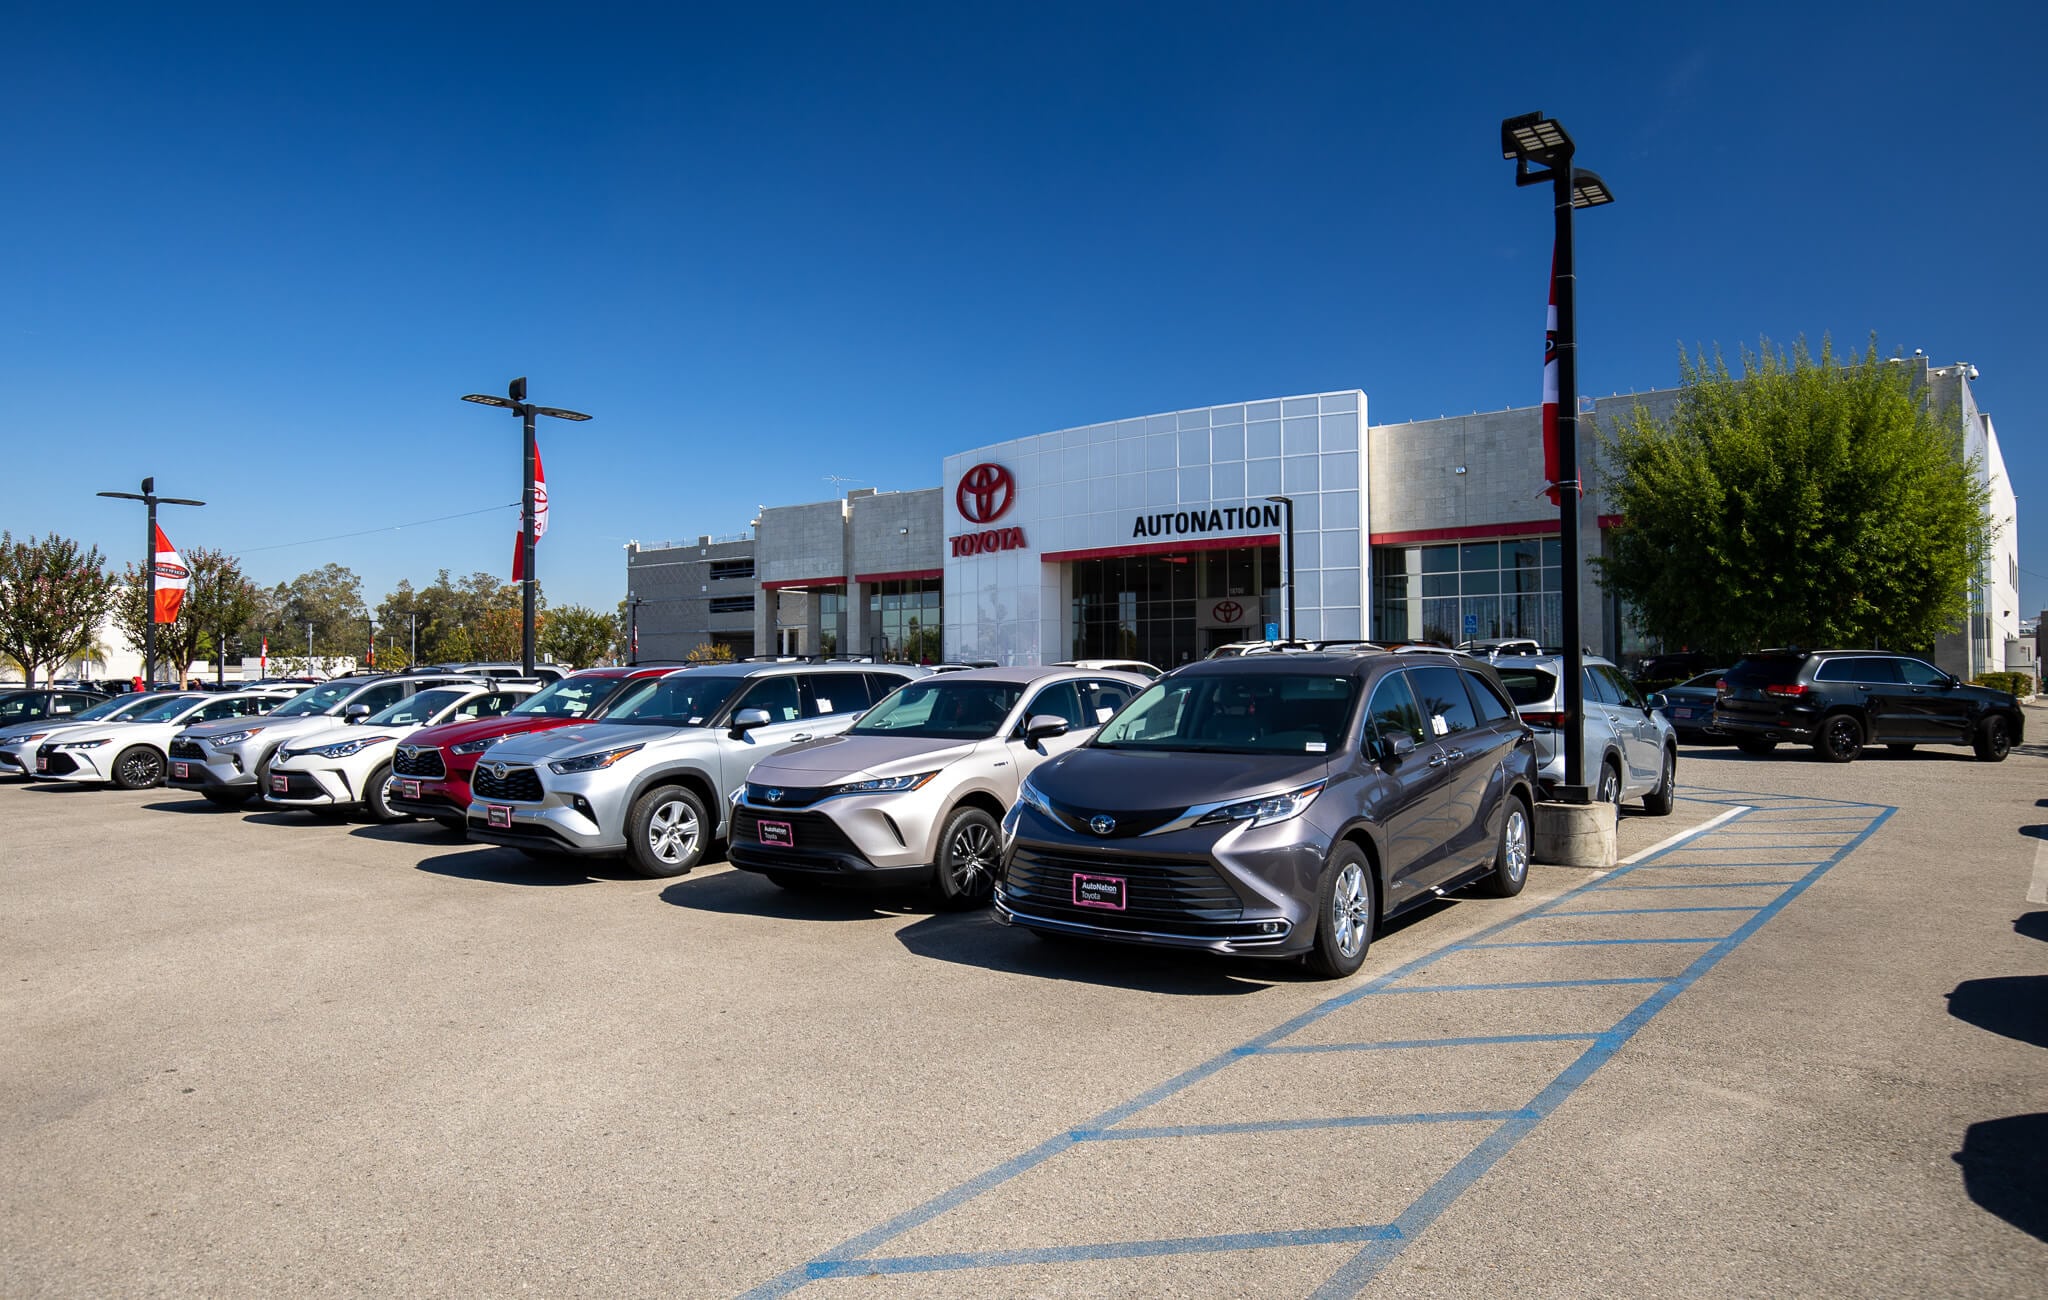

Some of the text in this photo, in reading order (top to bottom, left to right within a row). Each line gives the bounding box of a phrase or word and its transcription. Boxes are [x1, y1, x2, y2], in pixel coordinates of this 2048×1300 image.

[1133, 505, 1280, 537] AUTONATION
[949, 527, 1026, 558] TOYOTA
[1081, 890, 1101, 900] Toyota
[1082, 882, 1117, 892] AutoNation
